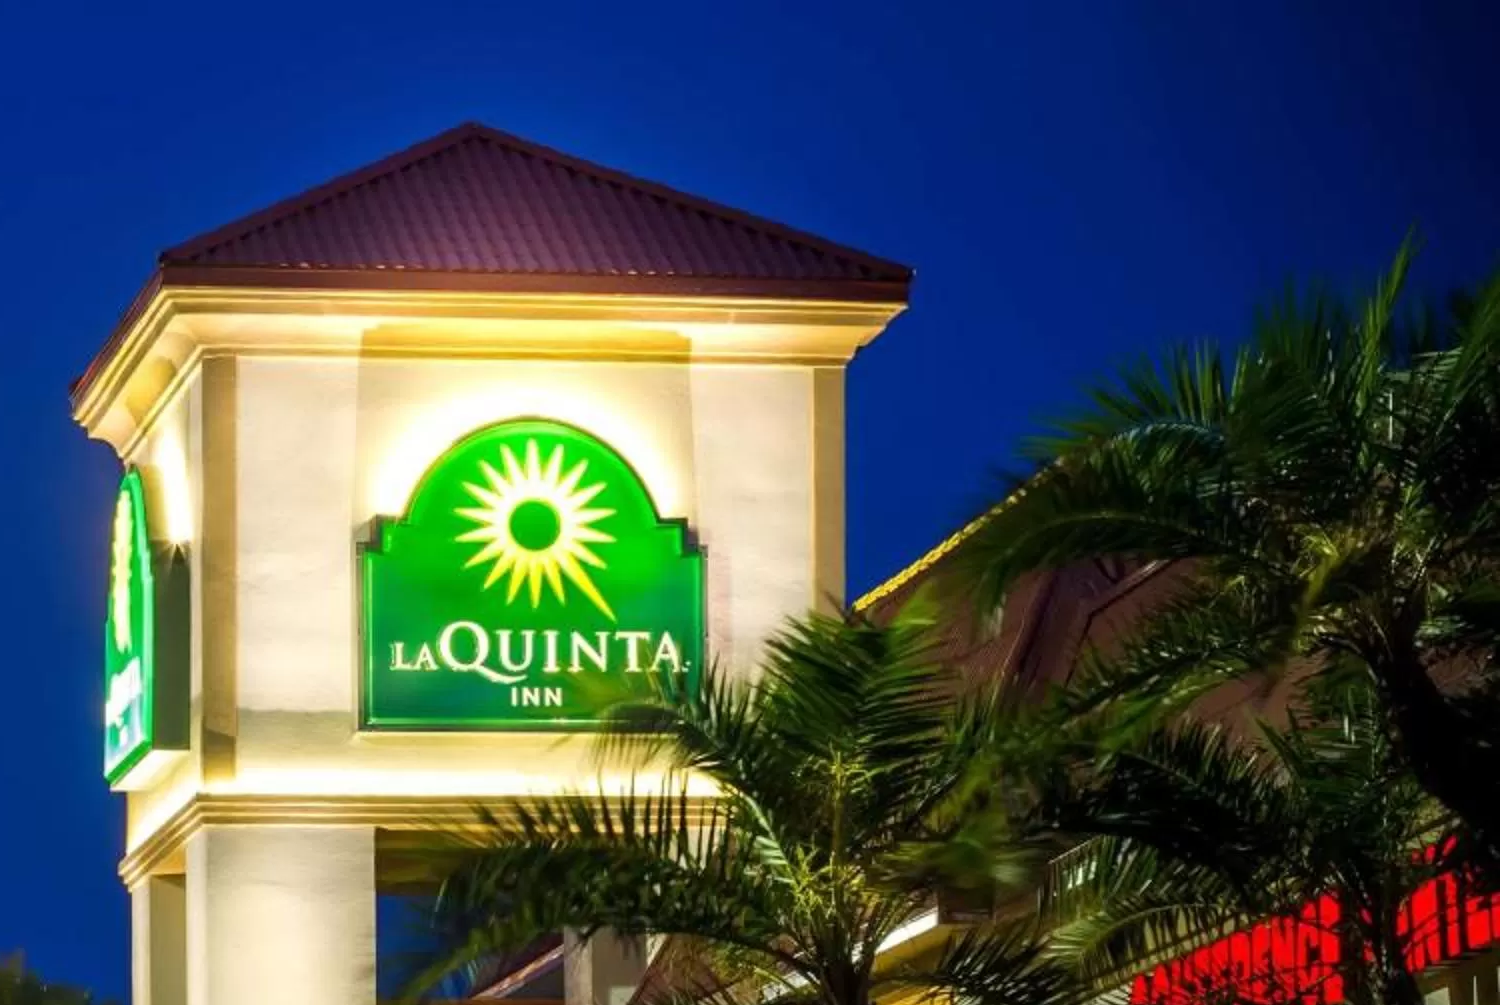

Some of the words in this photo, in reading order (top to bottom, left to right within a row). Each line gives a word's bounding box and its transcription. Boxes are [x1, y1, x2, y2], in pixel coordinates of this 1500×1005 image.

[389, 642, 438, 671] LA
[438, 620, 682, 685] QUINTA
[510, 686, 563, 707] INN
